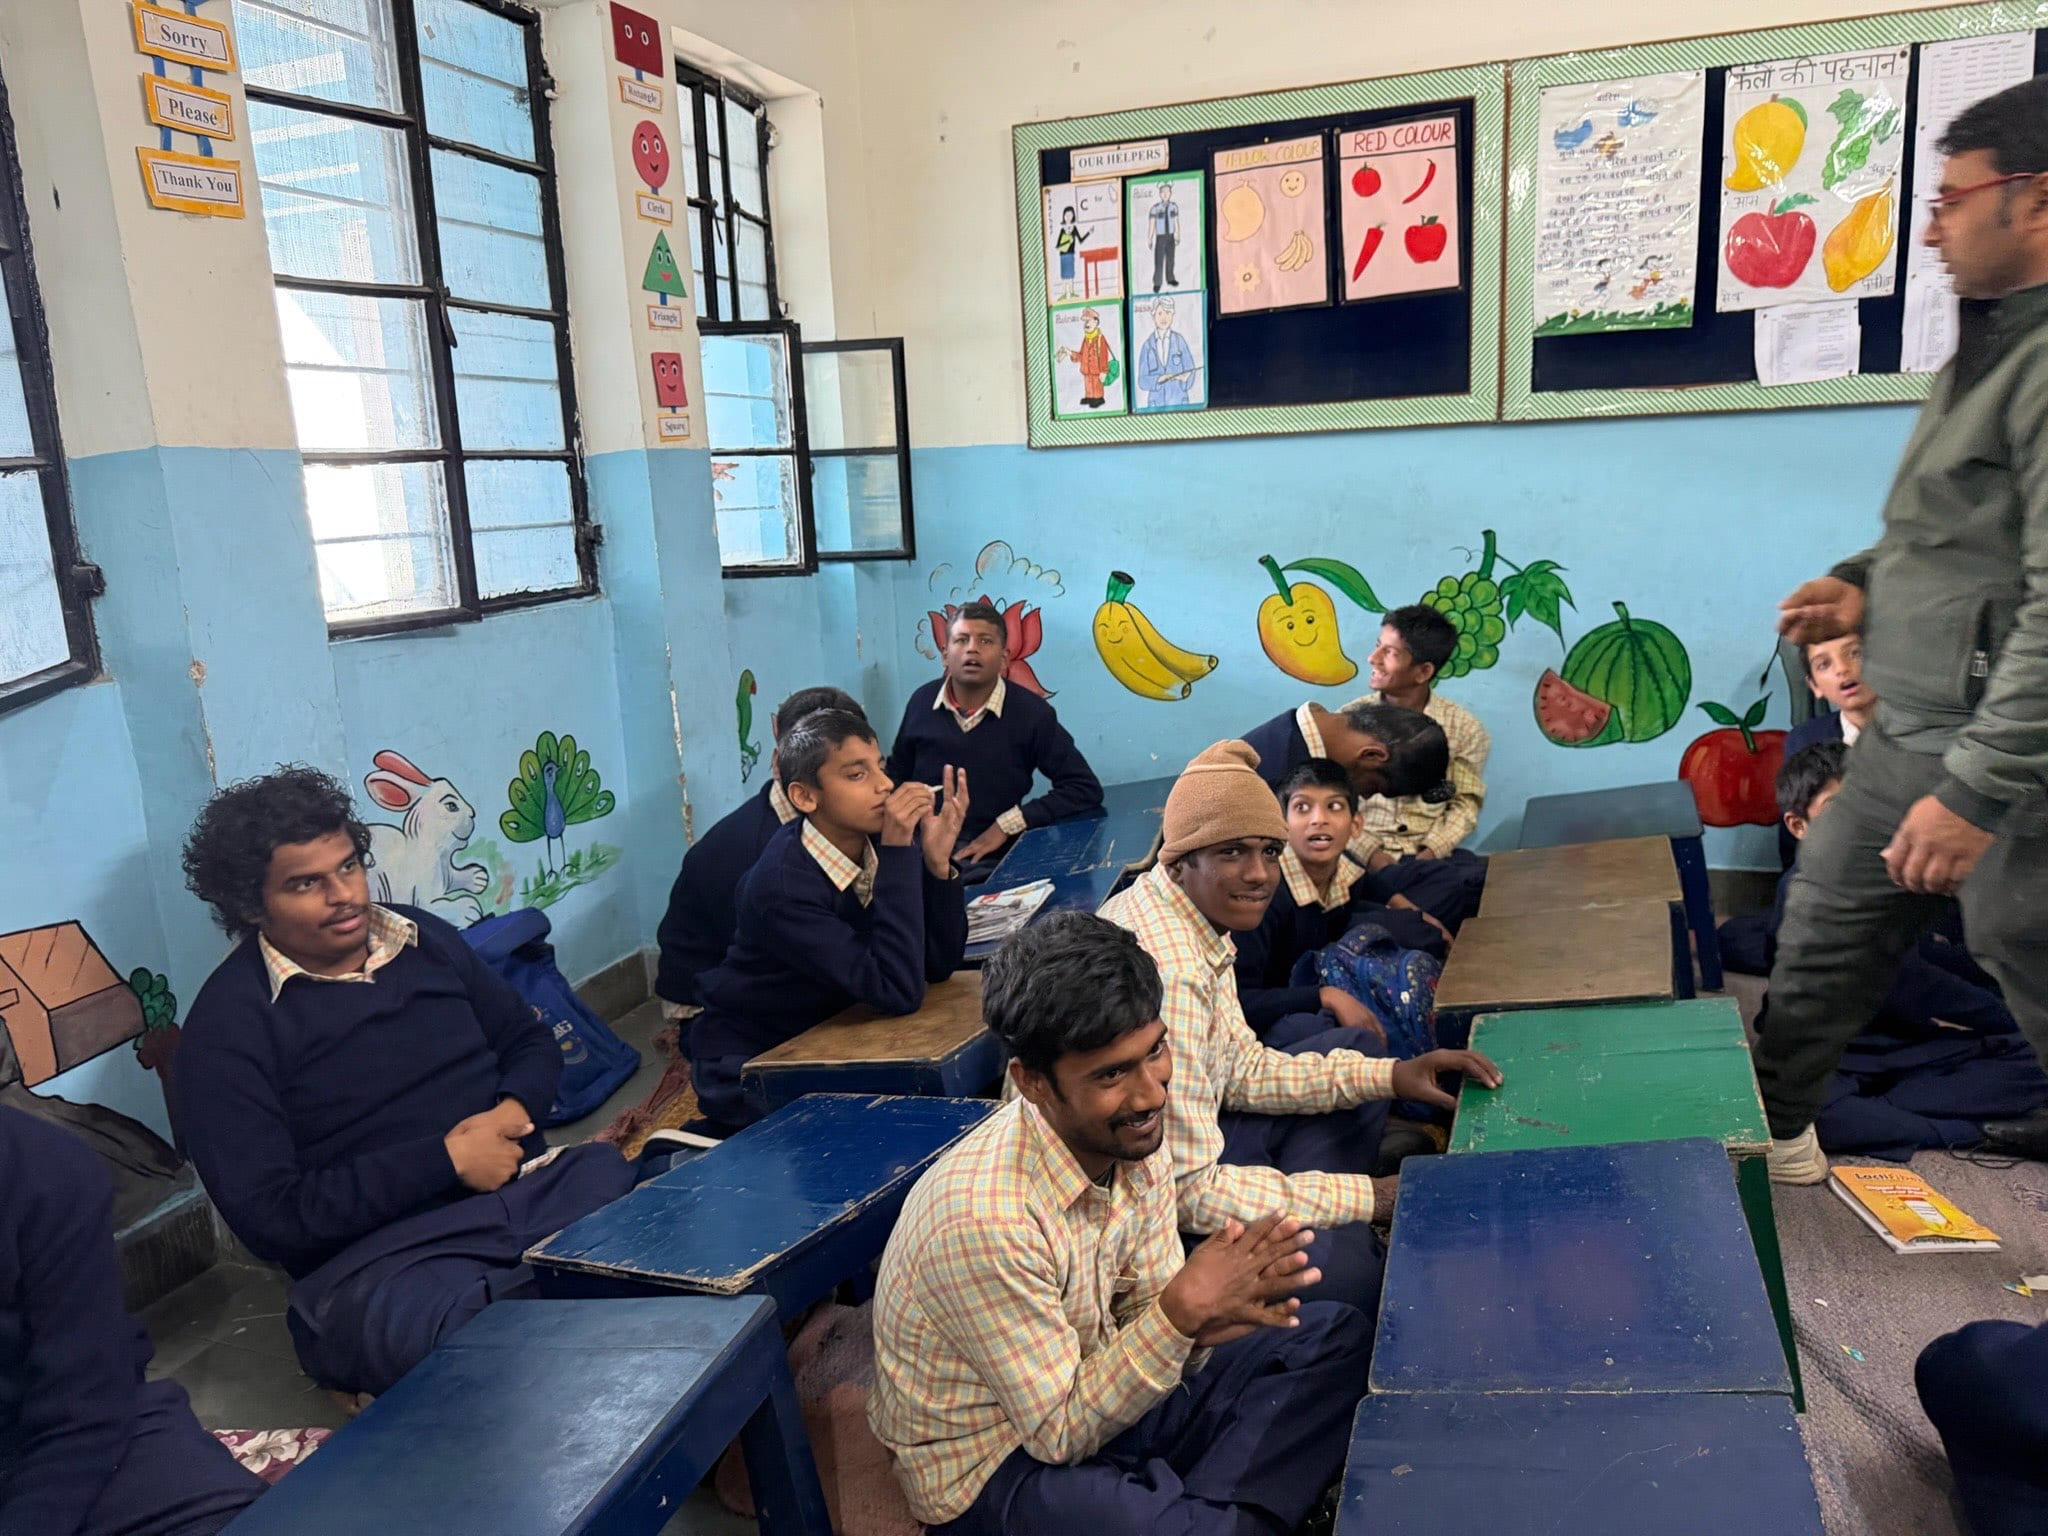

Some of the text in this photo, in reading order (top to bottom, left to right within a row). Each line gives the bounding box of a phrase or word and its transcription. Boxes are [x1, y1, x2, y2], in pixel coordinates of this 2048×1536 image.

[160, 24, 207, 53] Sorry
[1779, 57, 1817, 85] की
[1820, 52, 1897, 83] पहचान
[627, 85, 657, 104] Rectangle
[168, 98, 218, 126] Please
[1353, 122, 1452, 152] RED COLOUR
[1078, 149, 1162, 169] OUR HELPERS
[1275, 141, 1320, 159] COLOUR
[158, 169, 233, 193] Thank You
[647, 201, 665, 215] Circle
[1080, 198, 1089, 211] C
[652, 310, 678, 324] Triangle
[665, 418, 685, 433] Square
